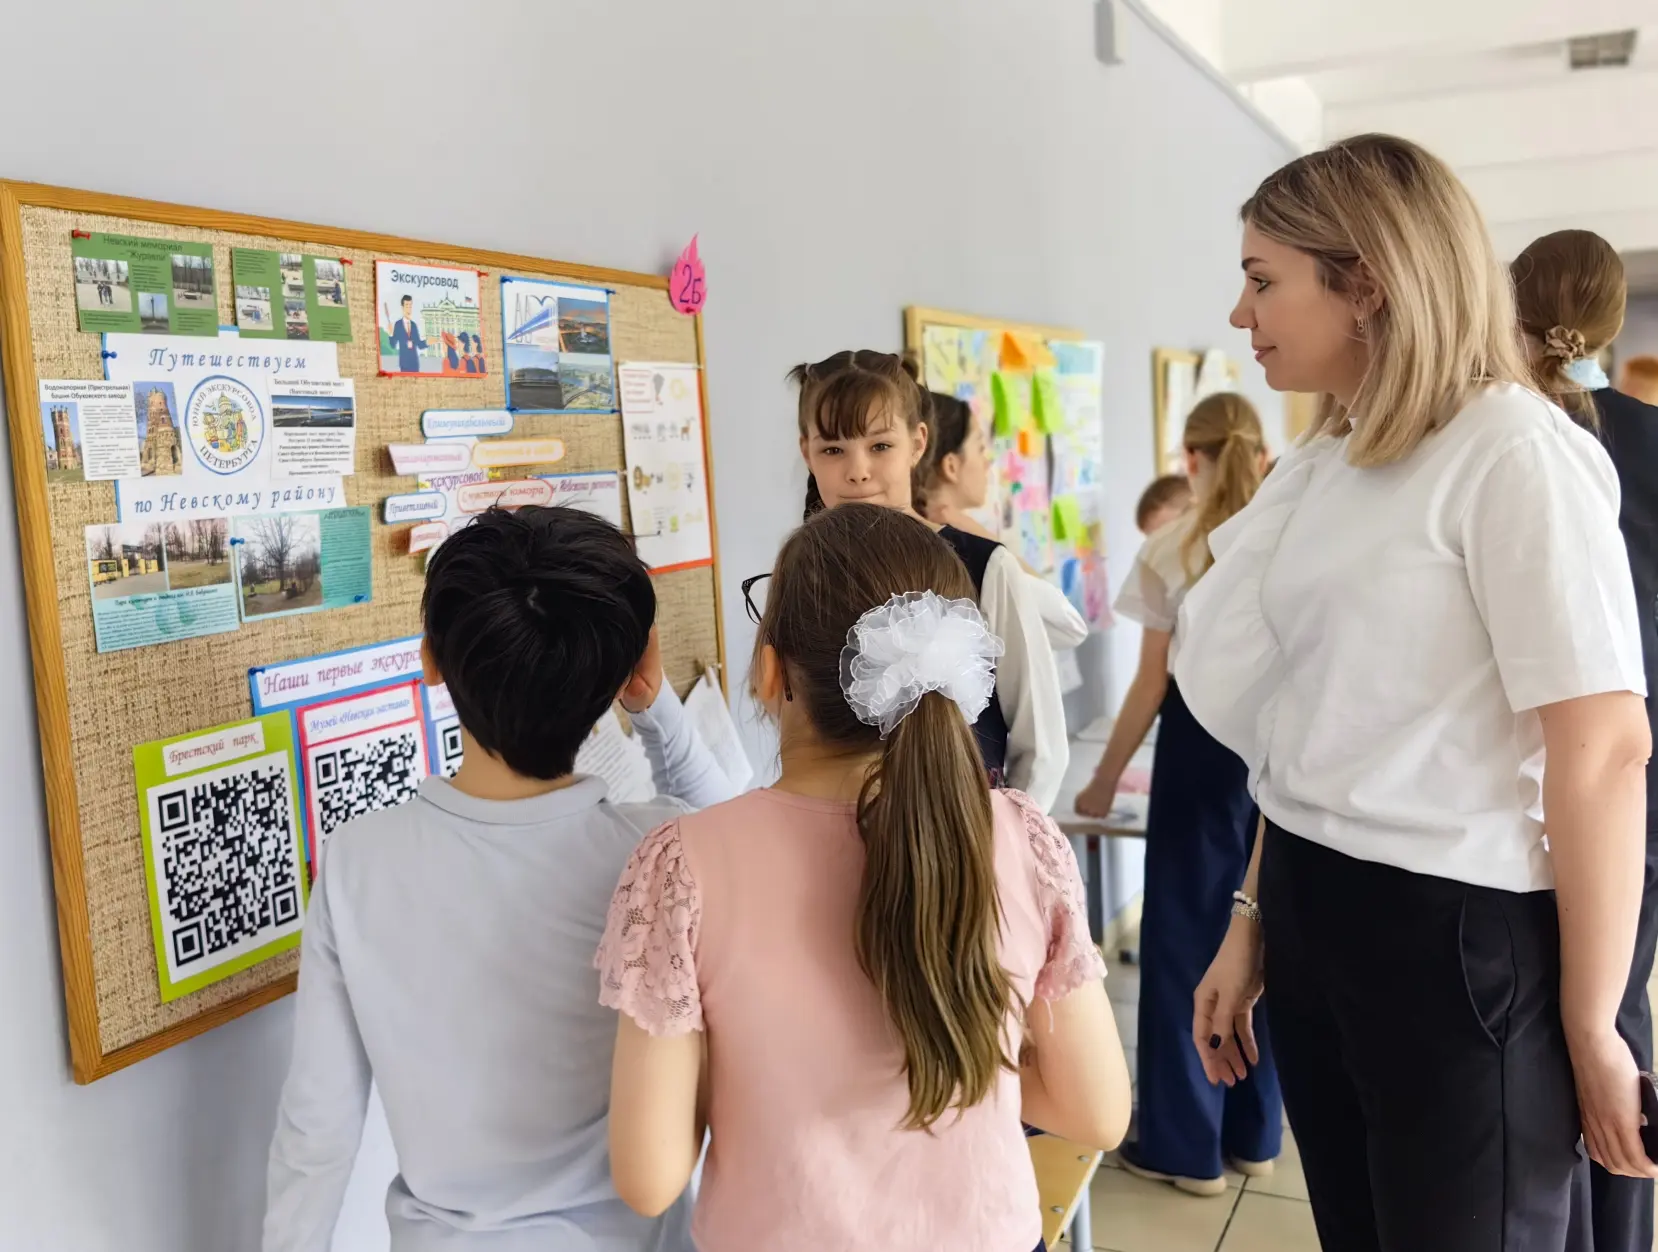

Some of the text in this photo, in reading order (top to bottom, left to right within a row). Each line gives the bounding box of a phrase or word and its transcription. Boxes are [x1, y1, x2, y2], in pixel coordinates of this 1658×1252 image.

[390, 269, 458, 289] Экскурсовод
[148, 348, 307, 373] Путешествуем
[193, 384, 257, 426] ЮНЫЙ ЭКСКУРСОВОД
[200, 440, 257, 468] ПЕТЕРБУРГА
[135, 485, 335, 513] по Невскому району
[264, 649, 421, 696] Наши первые экскурс
[309, 715, 339, 734] Музей
[168, 732, 261, 764] Брестский парк
